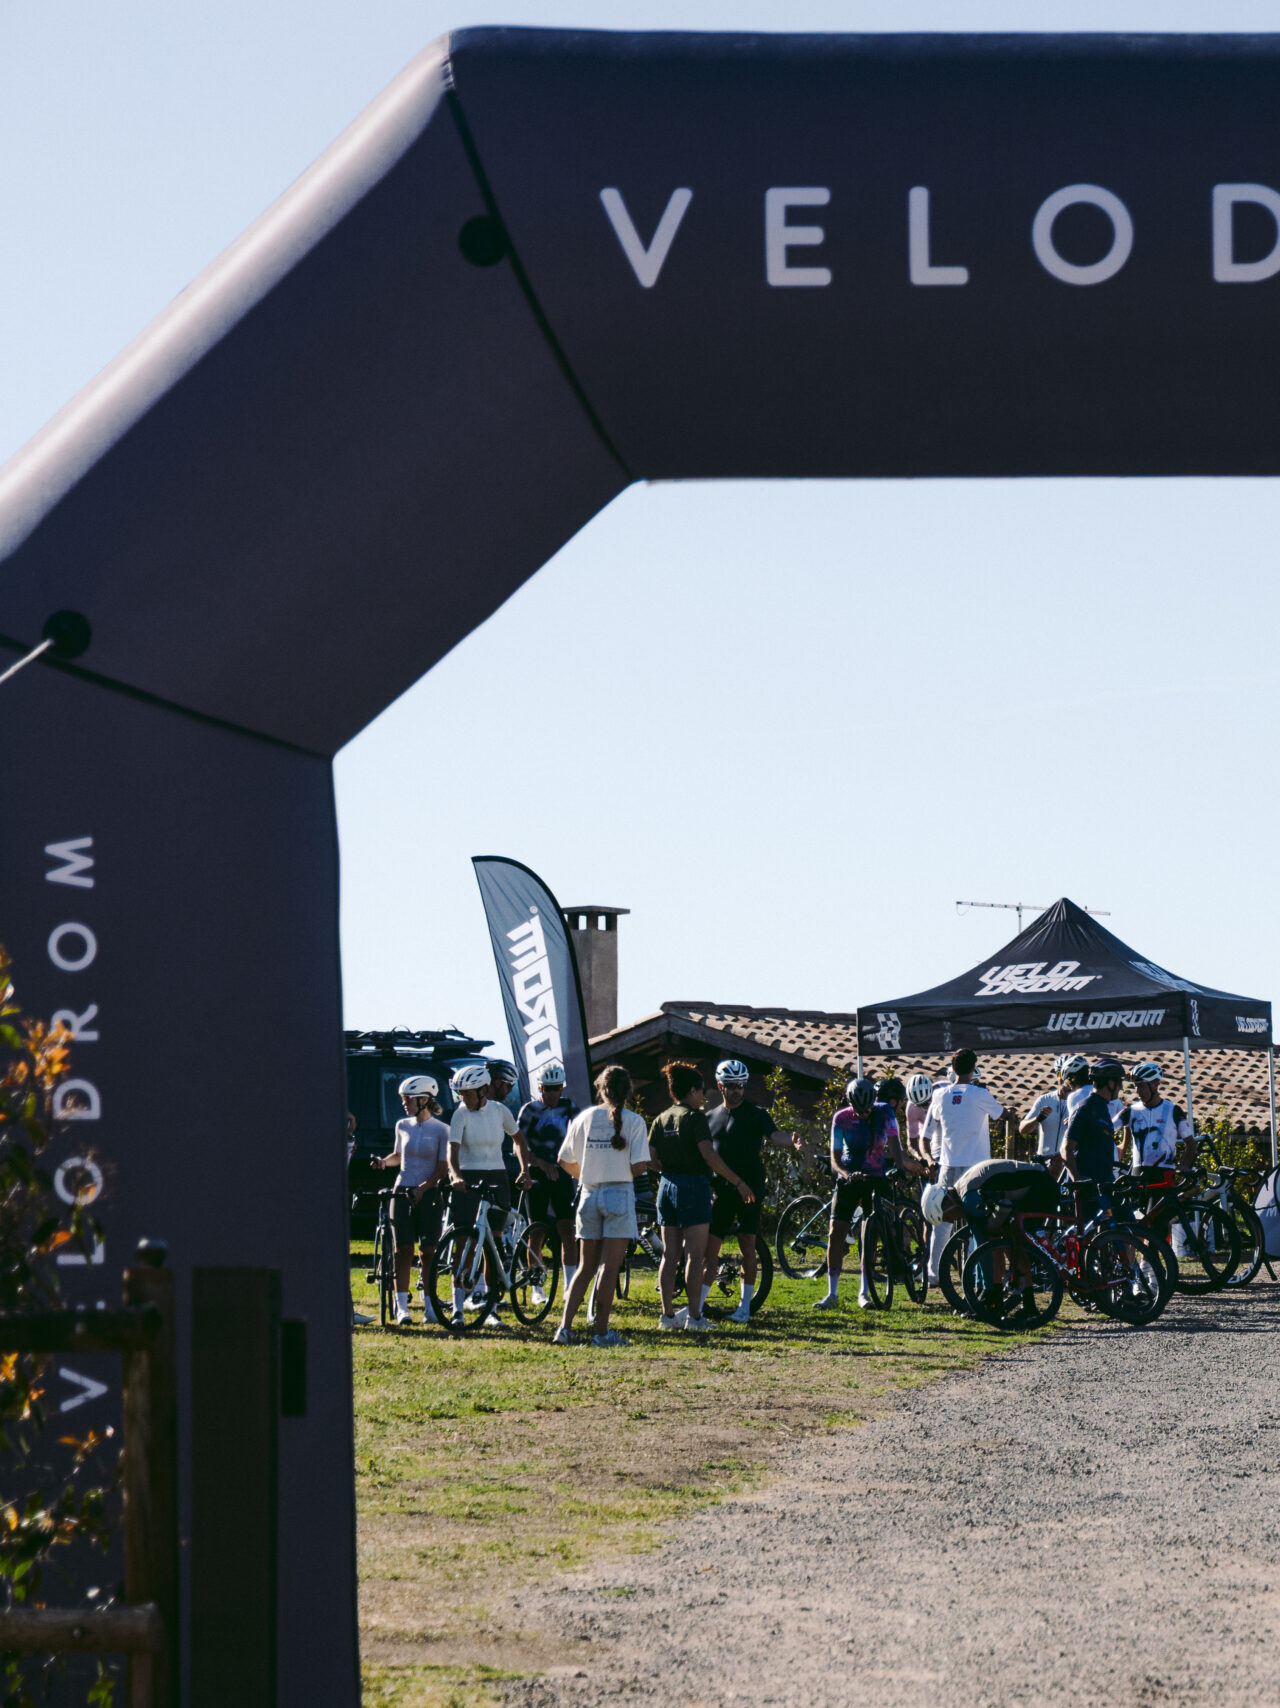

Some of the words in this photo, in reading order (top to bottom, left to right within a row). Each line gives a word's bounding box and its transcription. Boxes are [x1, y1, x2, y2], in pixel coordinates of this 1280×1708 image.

[979, 961, 1081, 981] VELO
[974, 975, 1096, 996] DROM
[1046, 1009, 1167, 1032] VELODROM
[45, 836, 108, 1412] VLODROM
